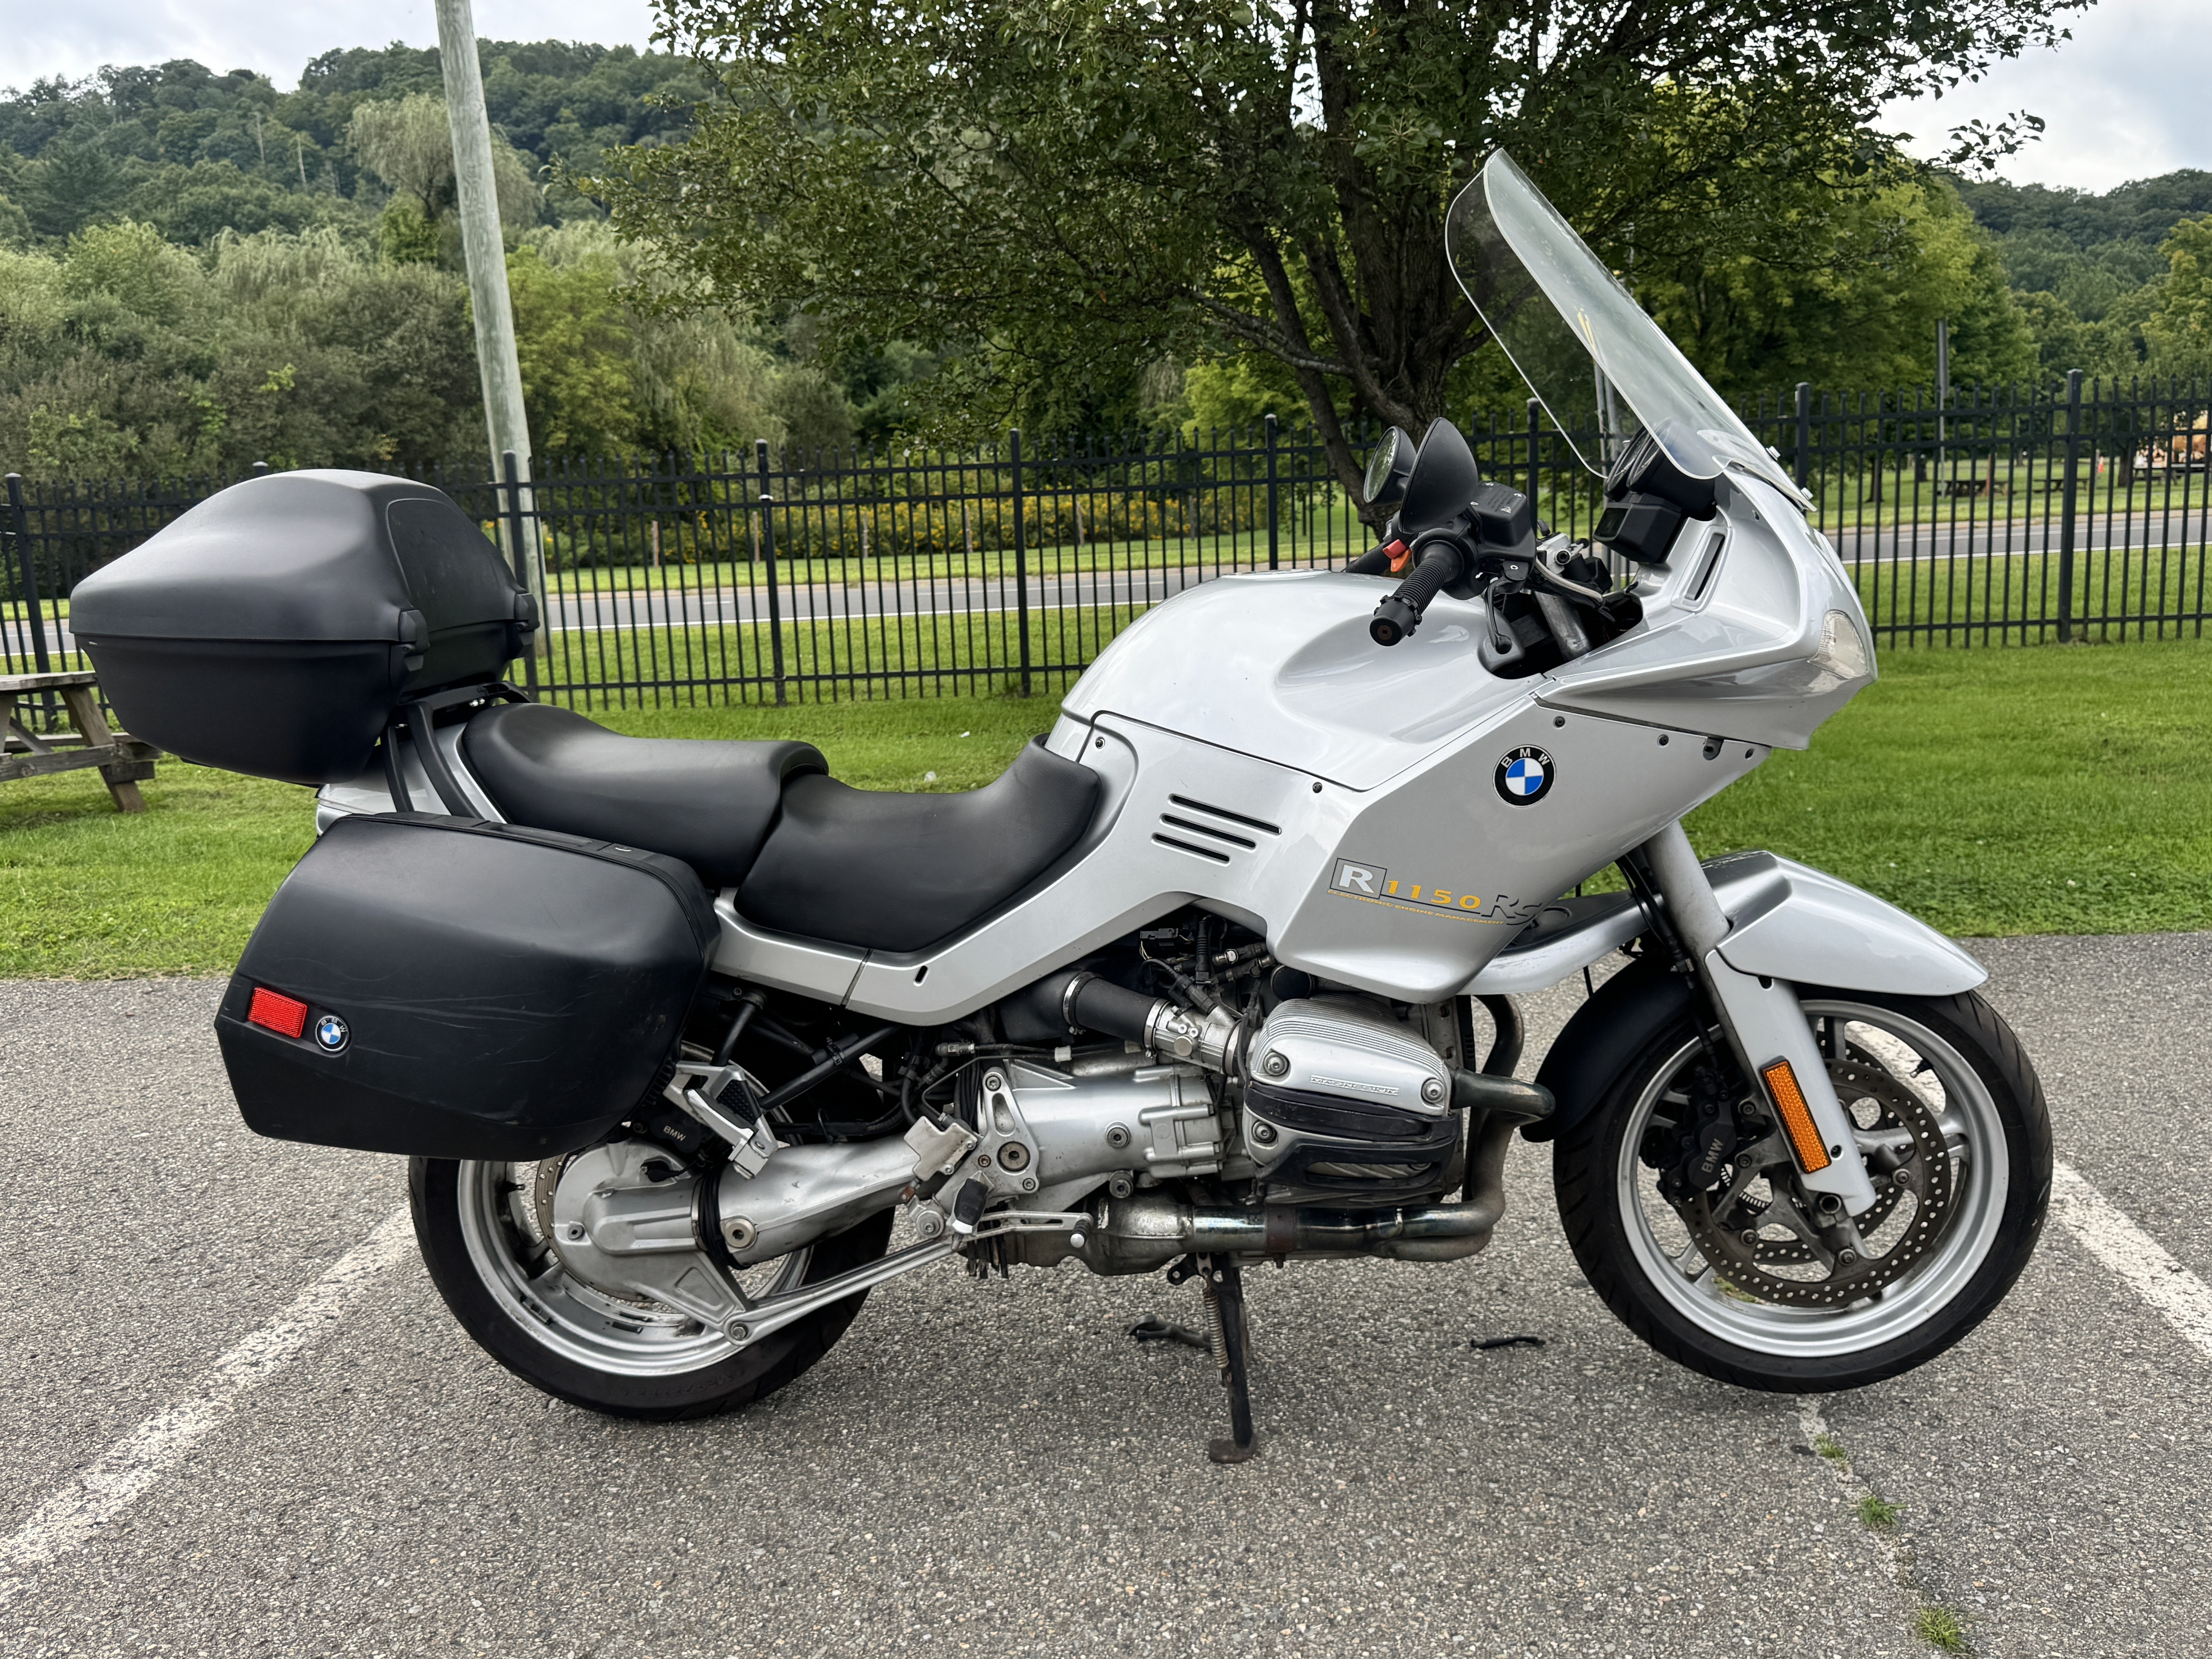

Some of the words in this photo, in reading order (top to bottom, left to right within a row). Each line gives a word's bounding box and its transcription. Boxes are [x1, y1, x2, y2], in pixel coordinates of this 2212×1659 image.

[1501, 747, 1550, 768] BMW
[1339, 864, 1374, 893] R
[1388, 880, 1480, 909] 1150
[1328, 889, 1393, 907] ELECTRONIC
[1395, 905, 1433, 915] ENGINE
[1435, 912, 1505, 924] MANAGEMENT
[321, 1018, 346, 1033] BMW
[1311, 1076, 1399, 1095] MAGNESIUM
[663, 1125, 686, 1141] BMW
[1701, 1138, 1723, 1173] BMW
